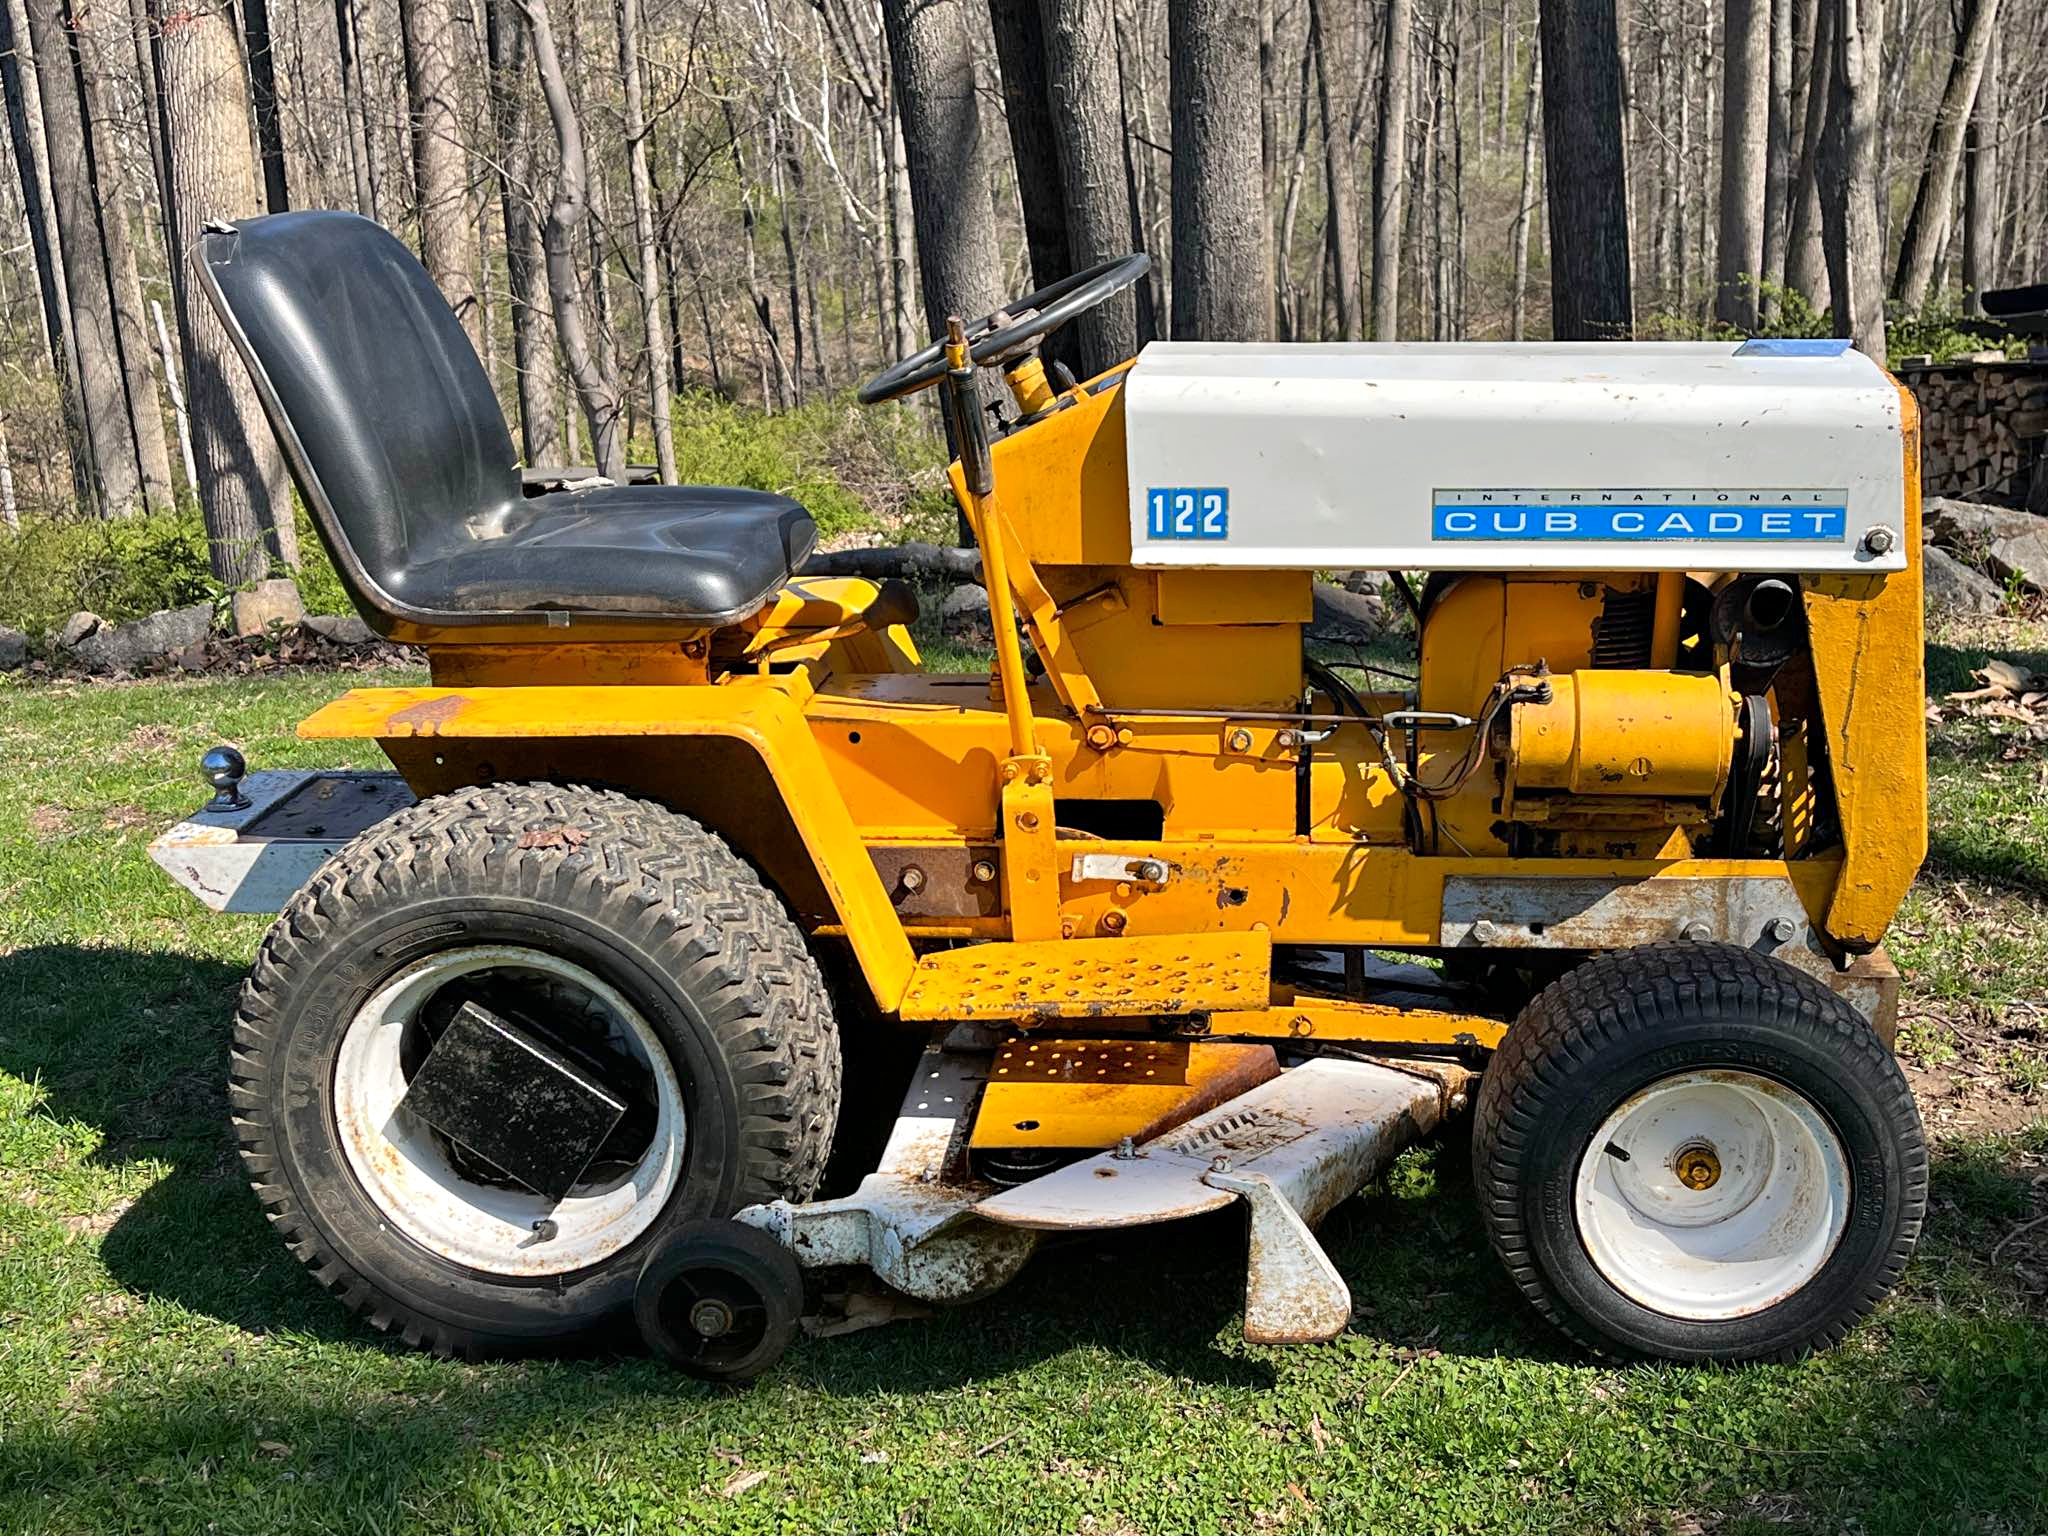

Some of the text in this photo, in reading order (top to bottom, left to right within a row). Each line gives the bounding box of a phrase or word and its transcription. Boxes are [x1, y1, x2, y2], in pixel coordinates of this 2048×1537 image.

[1456, 493, 1824, 502] INTERNATIONAL
[1152, 494, 1222, 533] 122
[1444, 512, 1837, 534] CUB CADET
